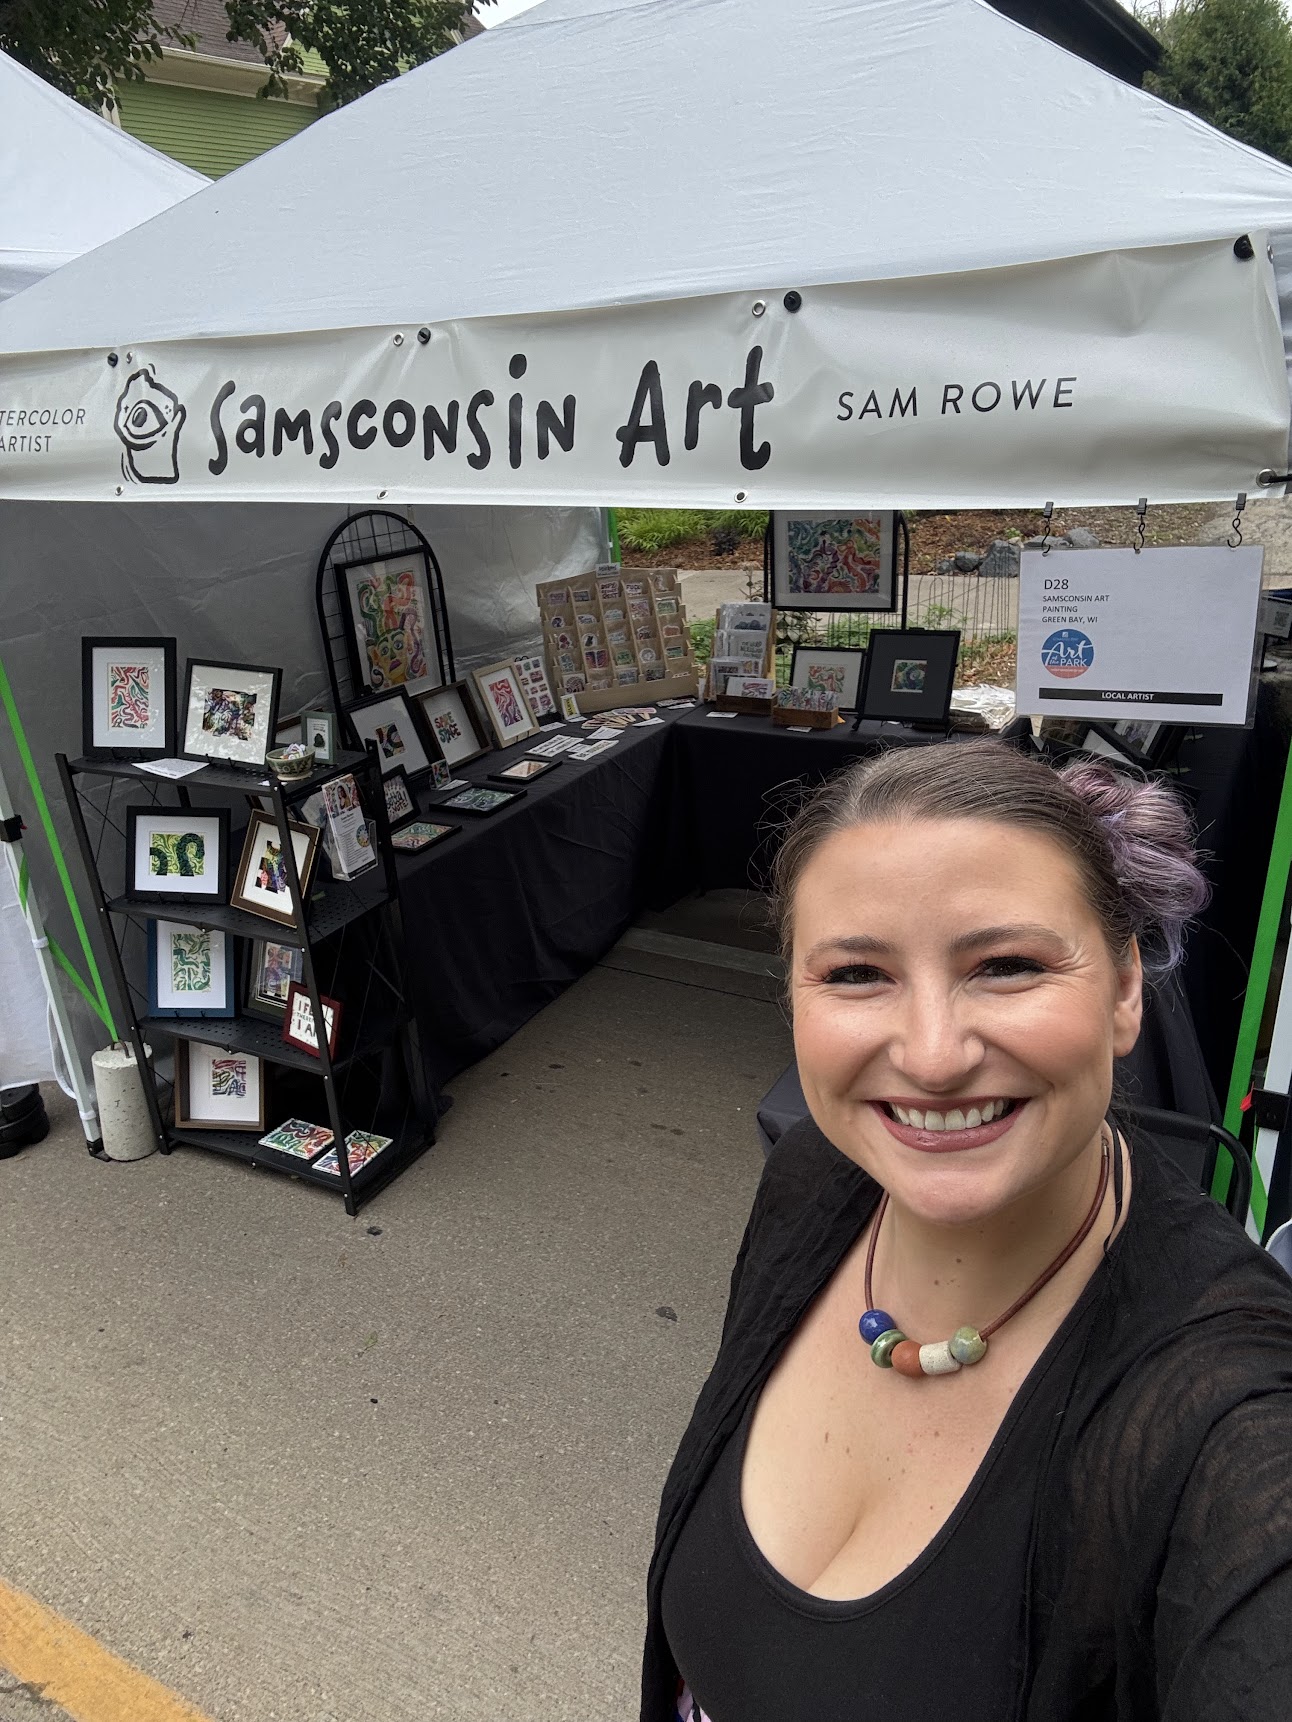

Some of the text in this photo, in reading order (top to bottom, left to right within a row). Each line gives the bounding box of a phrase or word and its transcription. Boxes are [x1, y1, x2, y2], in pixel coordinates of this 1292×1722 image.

[836, 377, 1077, 421] SAM ROWE
[615, 345, 774, 471] Art
[0, 435, 52, 452] ARTIST
[1044, 579, 1069, 590] D28
[1068, 616, 1085, 624] BAY,
[1042, 640, 1093, 666] Art
[1060, 658, 1088, 667] PARK
[1101, 691, 1155, 701] LOCAL ARTIST
[298, 1019, 302, 1031] I
